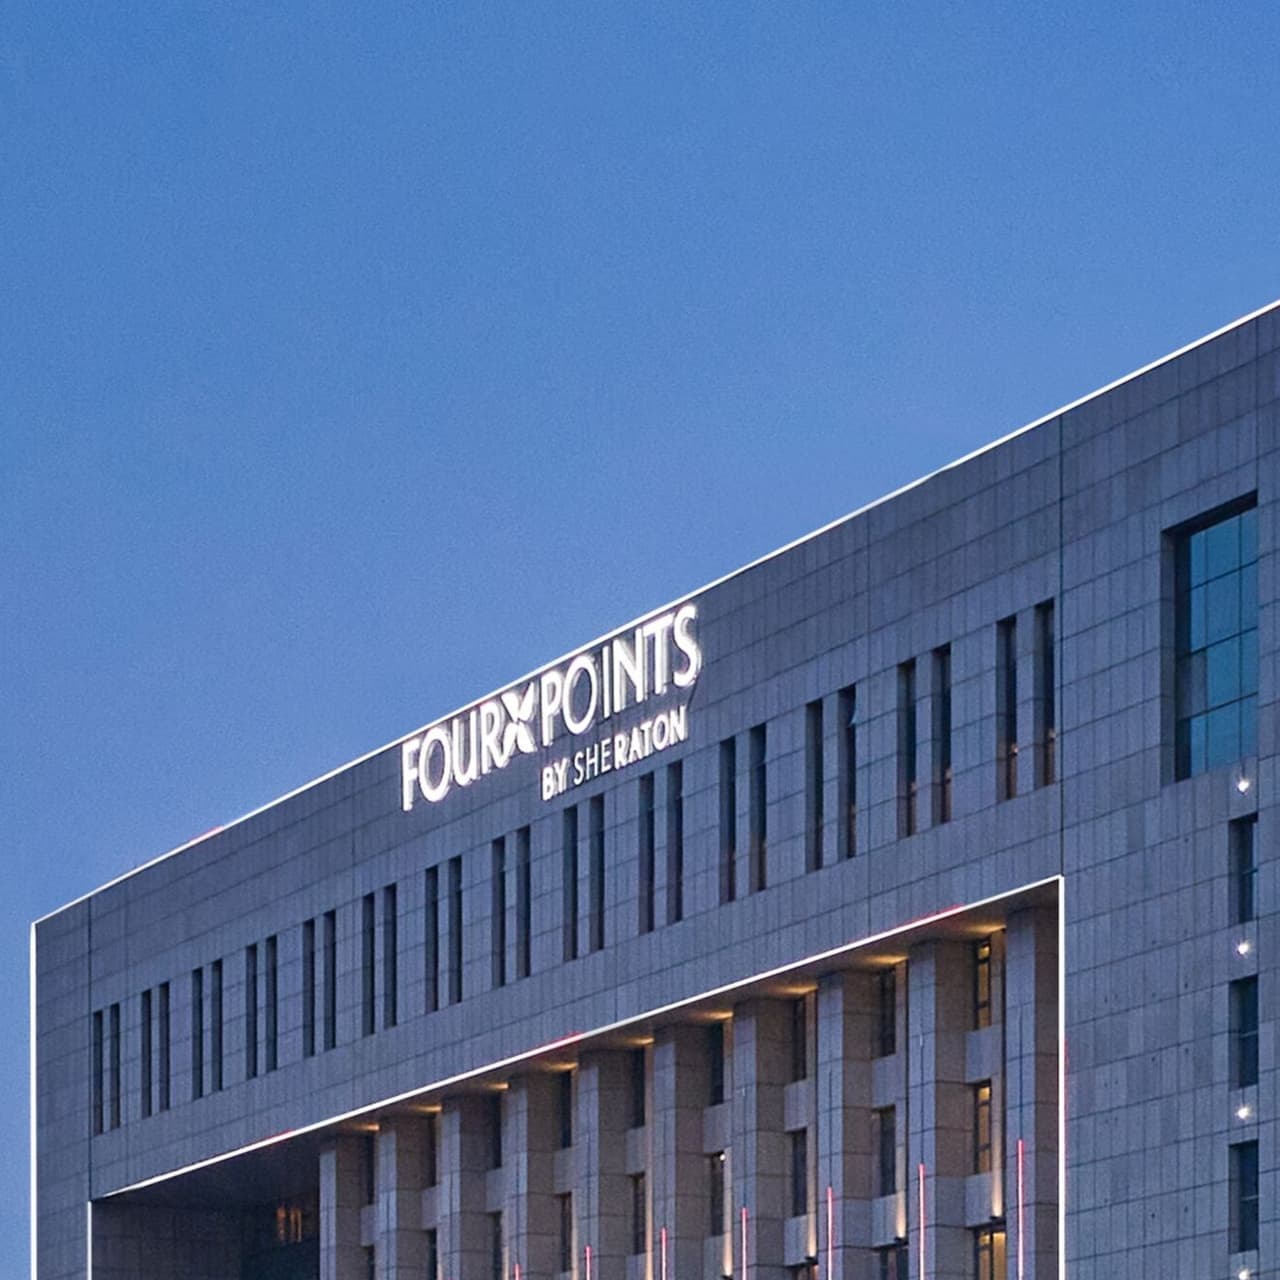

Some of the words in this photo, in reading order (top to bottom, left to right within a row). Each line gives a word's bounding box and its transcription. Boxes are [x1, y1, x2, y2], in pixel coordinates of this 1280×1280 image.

[401, 698, 509, 812] FOUR
[541, 603, 702, 748] POINTS
[542, 757, 568, 801] BY
[573, 704, 688, 787] SHERATON
